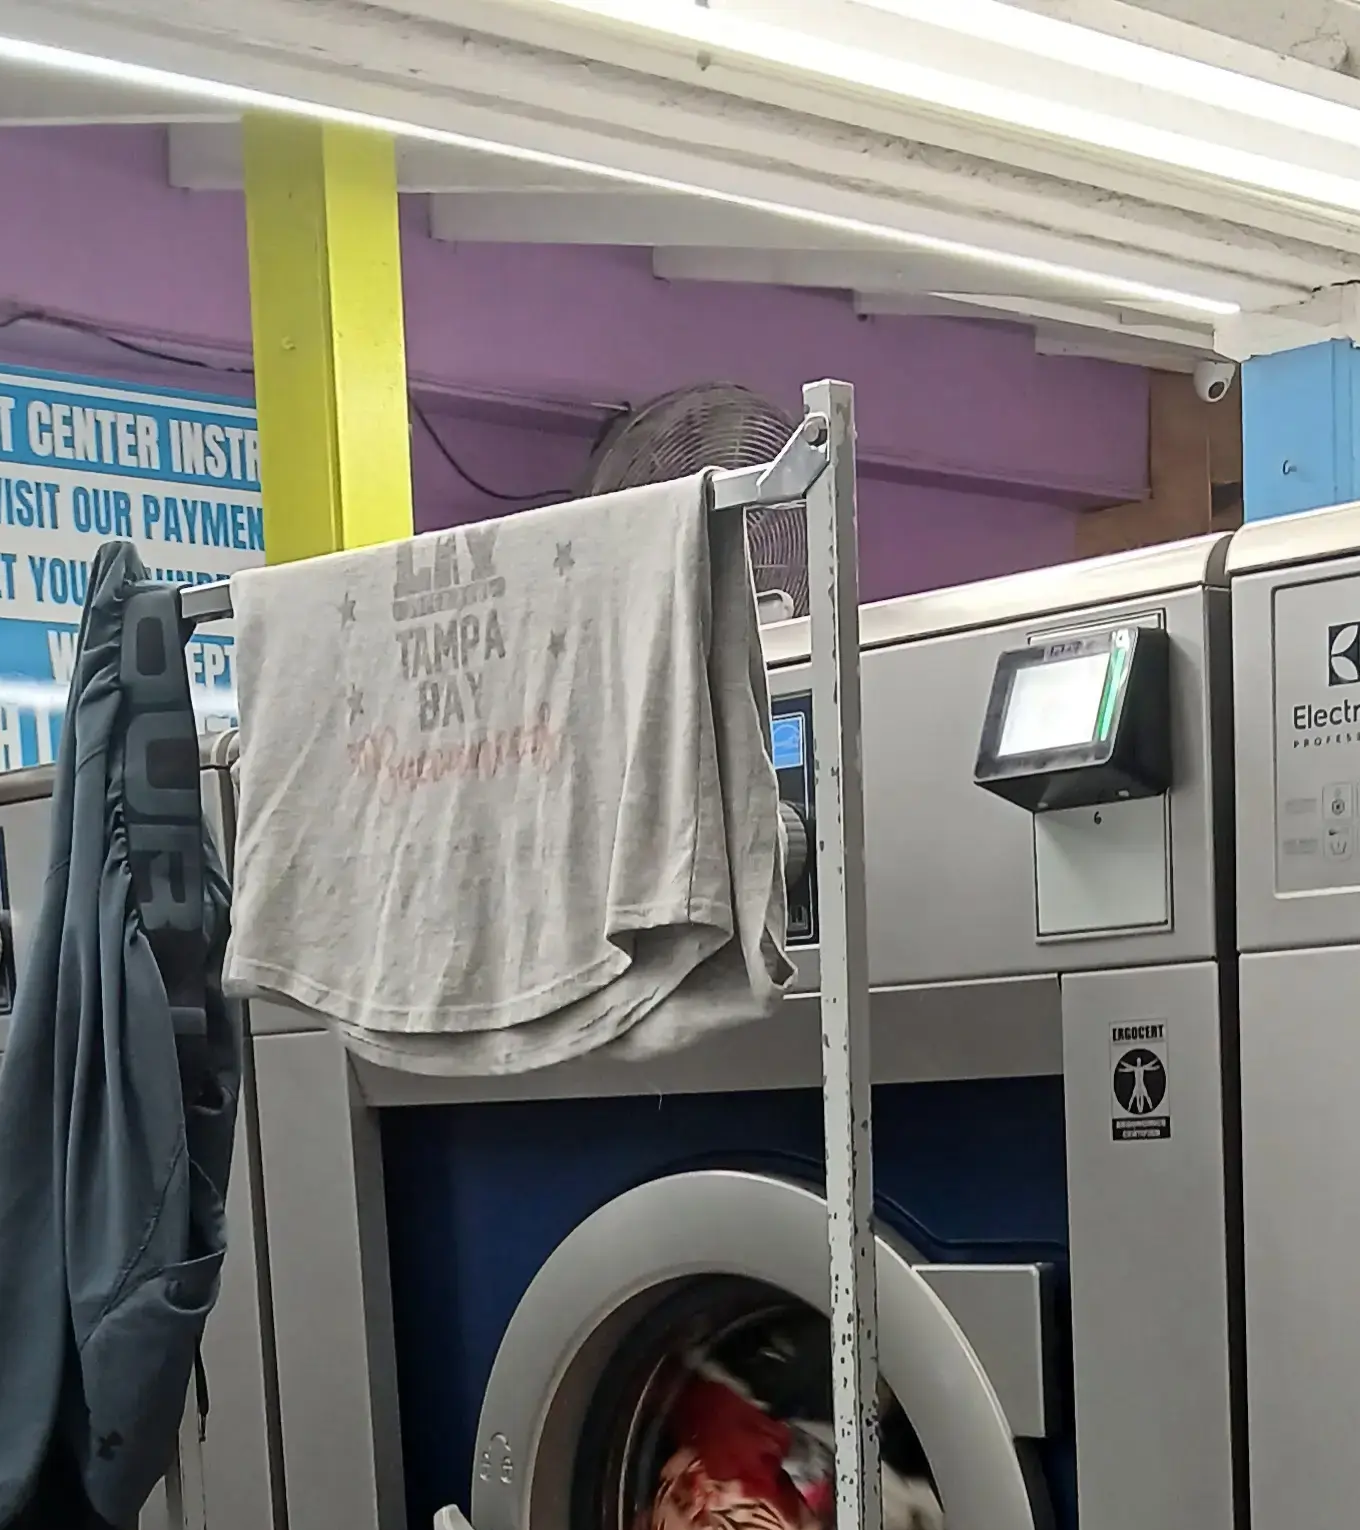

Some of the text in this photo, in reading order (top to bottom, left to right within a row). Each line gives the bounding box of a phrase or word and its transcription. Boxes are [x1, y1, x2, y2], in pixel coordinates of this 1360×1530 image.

[27, 400, 161, 471] CENTER
[73, 486, 133, 537] OUR
[143, 494, 265, 551] PAYMEN
[396, 608, 506, 680] TAMPA
[418, 670, 483, 733] BAY
